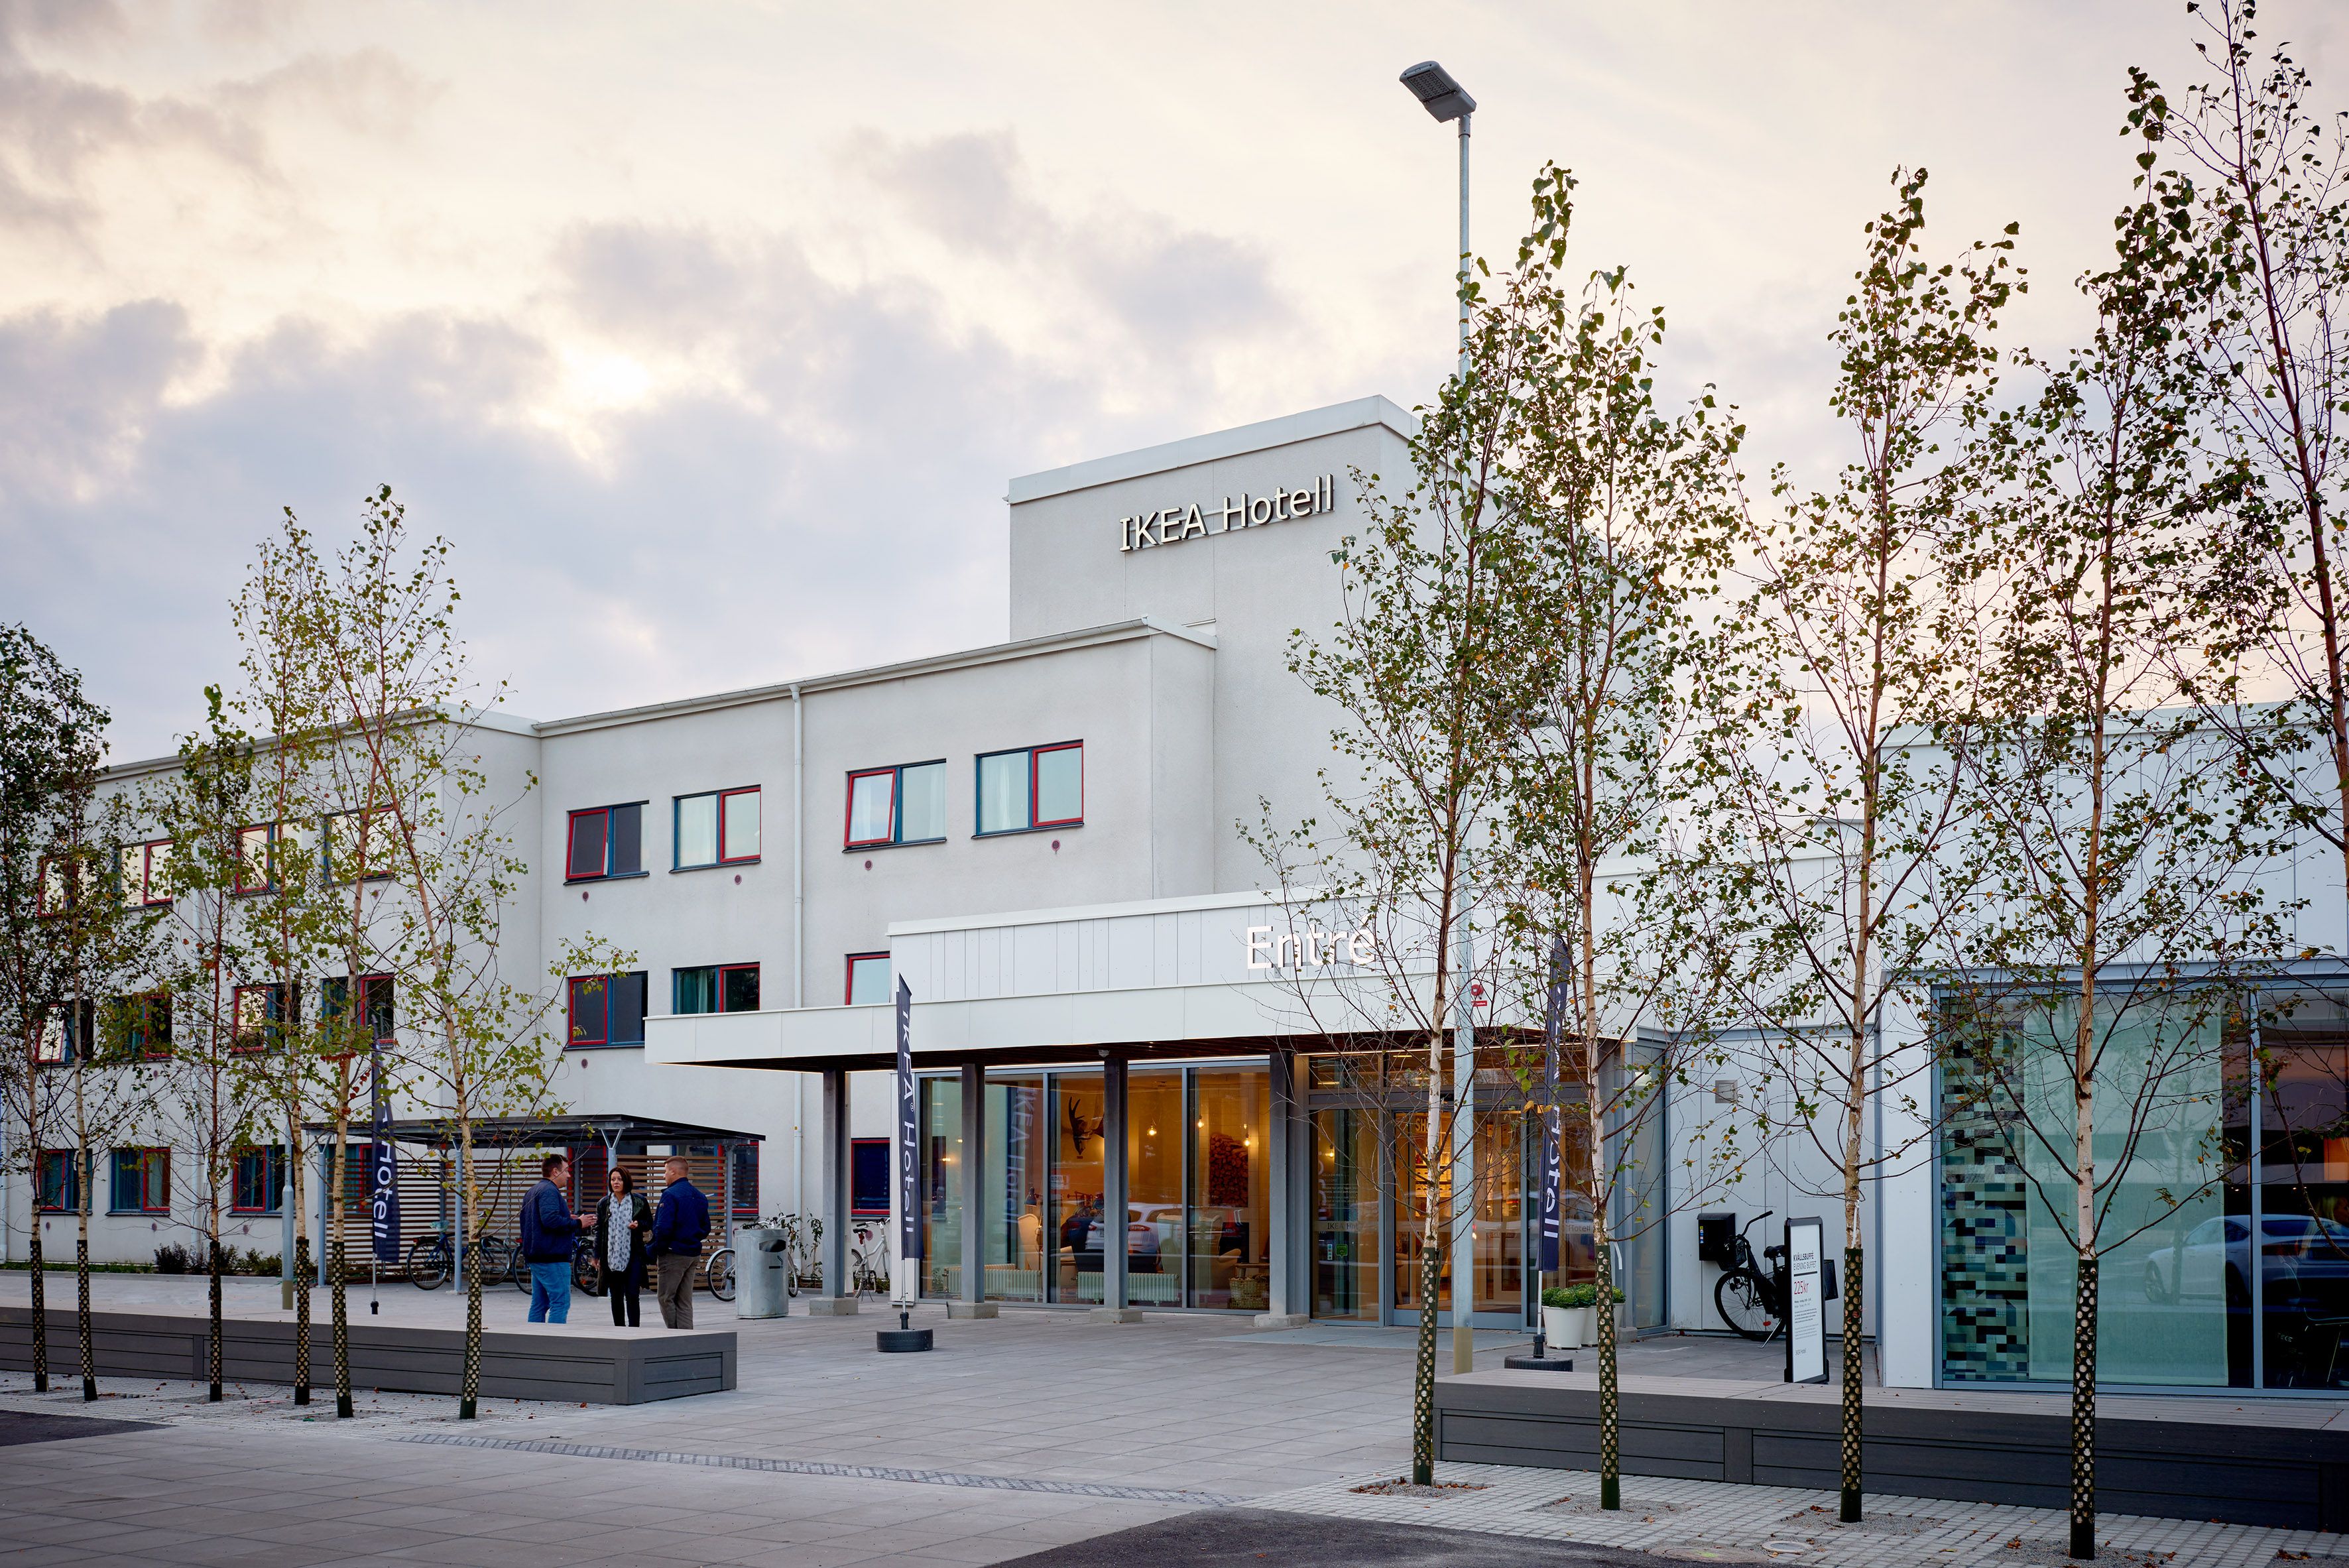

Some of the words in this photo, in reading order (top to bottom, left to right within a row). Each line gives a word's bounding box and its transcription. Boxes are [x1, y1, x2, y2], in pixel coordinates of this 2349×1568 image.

[1119, 503, 1209, 552] IKEA
[1223, 473, 1335, 531] Hotell
[1247, 912, 1376, 969] Entré
[904, 1120, 916, 1232] Hotell
[1793, 1250, 1814, 1261] KVÄLLSBUFFÉ
[1807, 1260, 1817, 1269] BUFFET
[1794, 1280, 1809, 1295] 225kr
